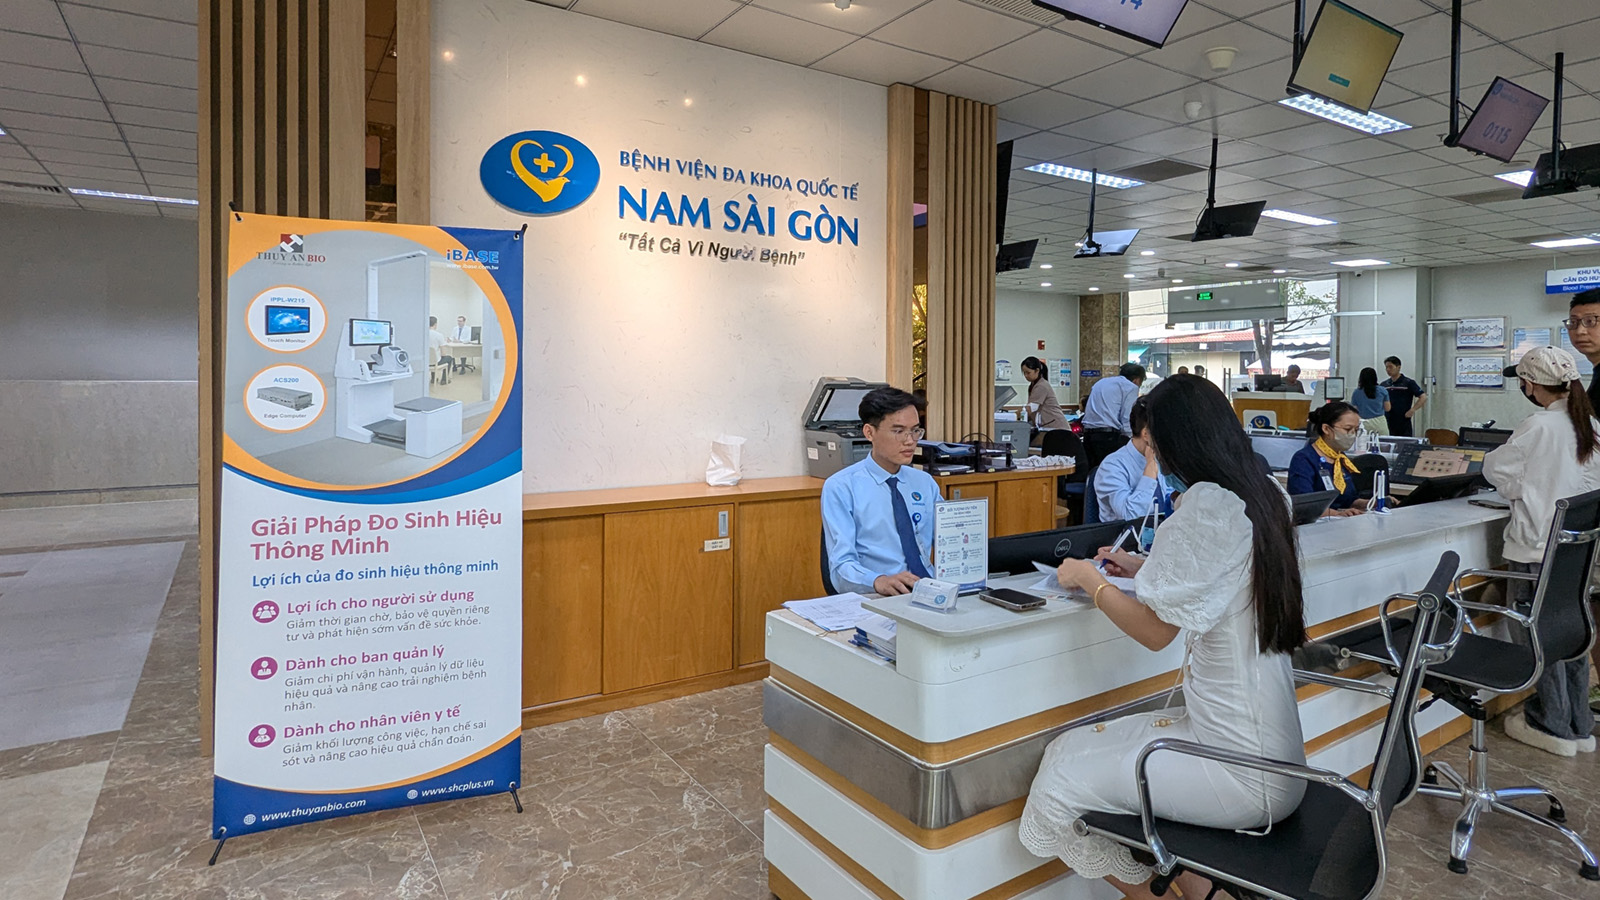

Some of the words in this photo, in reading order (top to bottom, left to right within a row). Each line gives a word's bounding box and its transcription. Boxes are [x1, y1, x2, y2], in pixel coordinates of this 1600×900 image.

[1482, 121, 1512, 144] 0115
[619, 148, 671, 173] BỆNH
[675, 158, 717, 181] VIỆN
[722, 166, 746, 185] ĐA
[750, 171, 793, 192] KHOA
[796, 177, 838, 198] QUỐC
[841, 182, 860, 201] TẾ
[618, 185, 712, 230] NAM
[723, 193, 776, 237] SÀI
[787, 204, 859, 247] GÒN
[307, 254, 326, 263] BIO
[446, 249, 499, 264] iBASE
[659, 237, 682, 254] Cả
[688, 240, 704, 257] Vì
[707, 242, 755, 262] Người
[251, 516, 297, 537] Giải
[305, 514, 362, 535] Pháp
[367, 514, 399, 531] Đo
[404, 510, 450, 529] Sinh
[456, 508, 502, 528] Hiệu
[250, 541, 325, 561] Thông
[331, 536, 389, 556] Minh
[1057, 544, 1069, 552] DELL
[252, 574, 276, 588] Lợi
[280, 572, 301, 586] ích
[305, 570, 331, 584] của
[335, 568, 354, 582] đo
[358, 566, 387, 580] sinh
[390, 564, 420, 579] hiệu
[424, 561, 463, 575] thông
[466, 559, 499, 573] minh
[287, 601, 311, 615] Lợi
[315, 599, 337, 612] ích
[341, 597, 367, 610] cho
[372, 593, 415, 609] người
[419, 591, 437, 603] sử
[440, 590, 475, 603] dụng
[286, 618, 316, 630] Giảm
[319, 616, 341, 627] thời
[344, 615, 366, 626] gian
[369, 612, 392, 623] chờ,
[395, 609, 415, 620] bảo
[417, 608, 429, 619] vệ
[431, 606, 462, 618] quyền
[465, 604, 490, 615] riêng
[286, 633, 300, 642] tư
[302, 631, 315, 640] và
[318, 628, 343, 640] phát
[345, 626, 369, 636] hiện
[372, 625, 395, 634] sớm
[397, 622, 416, 632] vấn
[418, 620, 432, 630] đề
[434, 620, 452, 629] sức
[454, 616, 481, 627] khỏe.
[286, 656, 326, 671] Dành
[330, 653, 357, 666] cho
[361, 651, 388, 663] ban
[392, 645, 428, 662] quản
[432, 644, 445, 658] lý
[284, 675, 314, 687] Giảm
[317, 673, 334, 684] chi
[336, 671, 355, 683] phí
[356, 669, 375, 680] vận
[378, 666, 408, 677] hành,
[410, 663, 436, 675] quản
[439, 661, 448, 672] lý
[450, 660, 465, 670] dữ
[466, 658, 484, 668] liệu
[284, 689, 309, 699] hiệu
[312, 685, 333, 698] quả
[336, 683, 348, 694] và
[351, 682, 378, 692] nâng
[380, 679, 399, 689] cao
[401, 676, 419, 687] trải
[421, 673, 459, 686] nghiệm
[462, 669, 487, 680] bệnh
[284, 700, 316, 712] nhân.
[284, 722, 324, 738] Dành
[328, 720, 355, 733] cho
[360, 714, 396, 729] nhân
[400, 710, 431, 724] viên
[434, 710, 443, 721] y
[446, 704, 462, 718] tế
[282, 742, 312, 754] Giảm
[315, 737, 339, 749] khối
[342, 735, 374, 747] lượng
[377, 731, 402, 742] công
[405, 727, 428, 738] việc,
[431, 725, 450, 735] hạn
[453, 721, 471, 731] chế
[473, 719, 487, 729] sai
[282, 756, 300, 767] sót
[303, 754, 315, 764] và
[319, 751, 346, 762] nâng
[348, 748, 368, 758] cao
[371, 743, 394, 755] hiệu
[396, 740, 416, 753] quả
[446, 734, 475, 745] đoán.
[421, 779, 494, 798] www.shcplus.vn
[261, 798, 366, 823] www.thuyanbio.com
